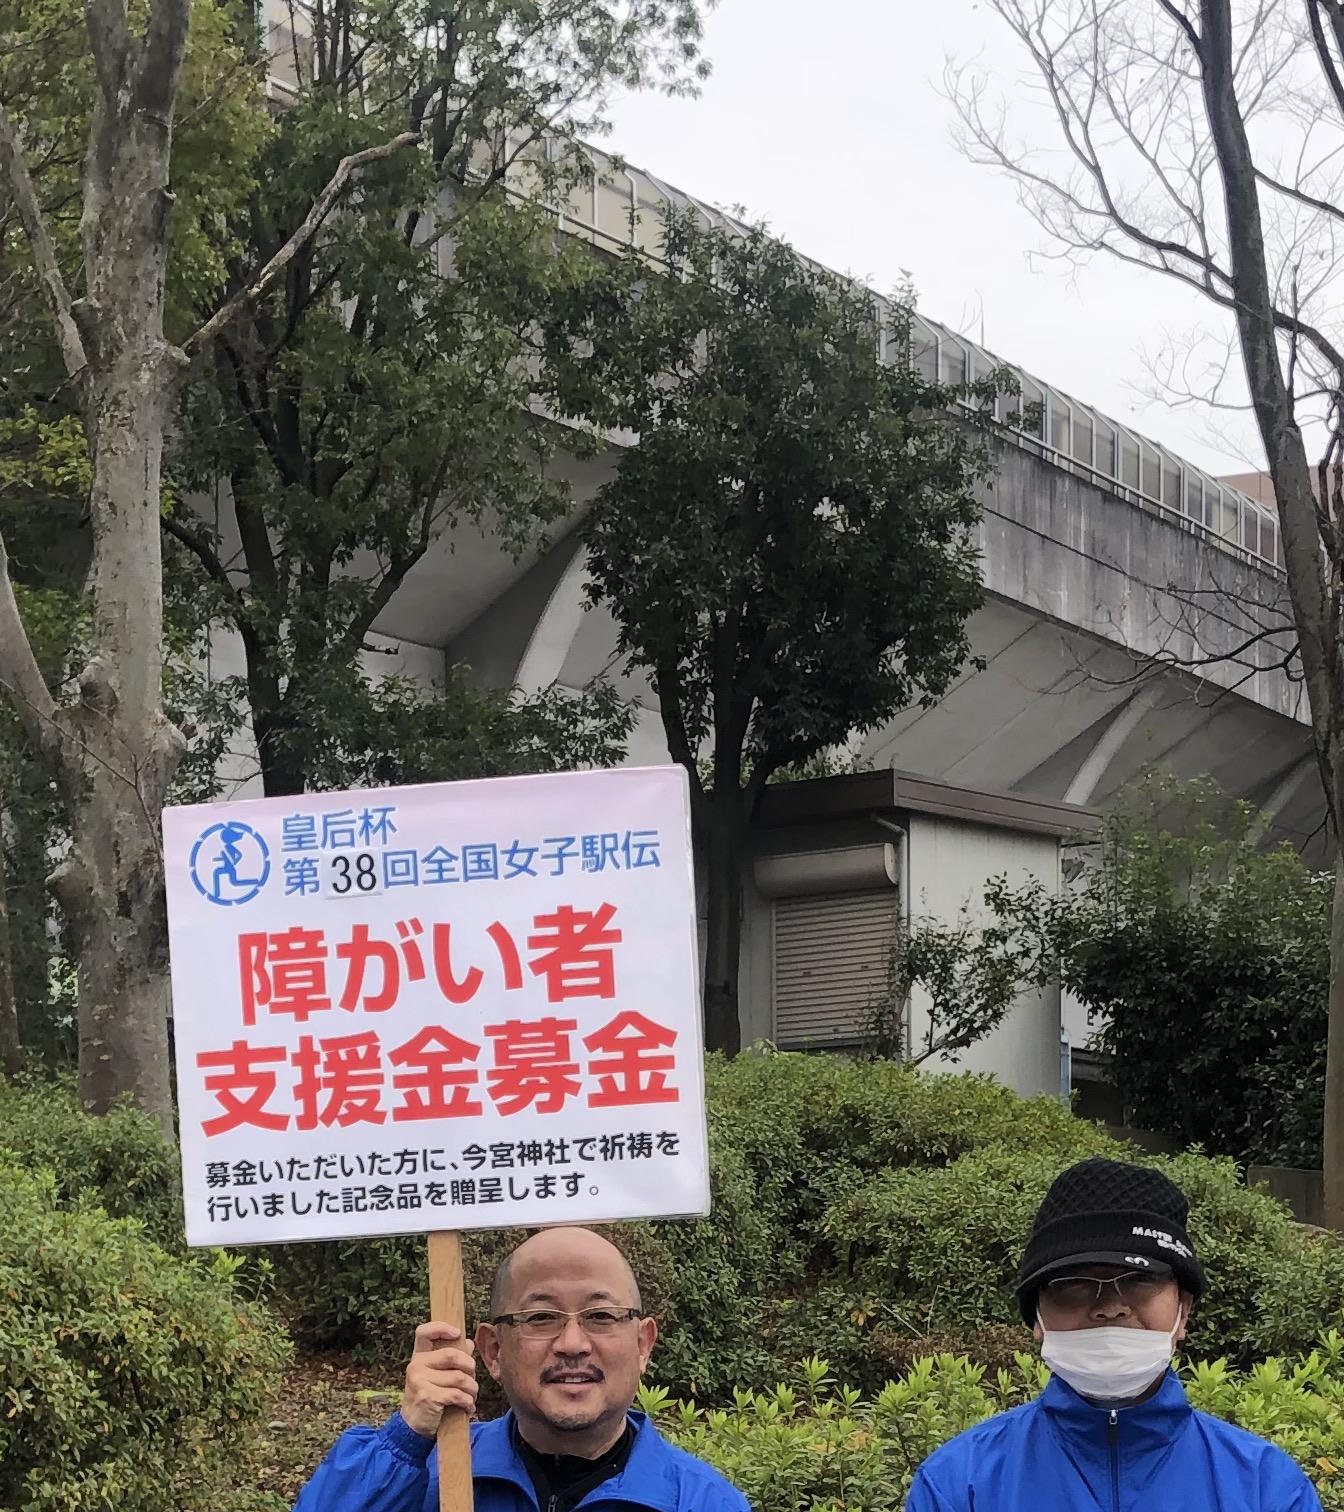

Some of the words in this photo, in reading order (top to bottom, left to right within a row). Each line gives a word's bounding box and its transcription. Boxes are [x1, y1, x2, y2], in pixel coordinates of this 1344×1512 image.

[281, 807, 397, 852] 皇后杯
[283, 829, 660, 897] 第38回全国女子駅伝
[238, 902, 622, 1026] 障がい者
[196, 1010, 680, 1137] 支援金募金
[206, 1131, 680, 1189] 募金いただいた方に、今宮神社で祈祷を
[207, 1172, 599, 1222] 行いました記念品を贈呈します。
